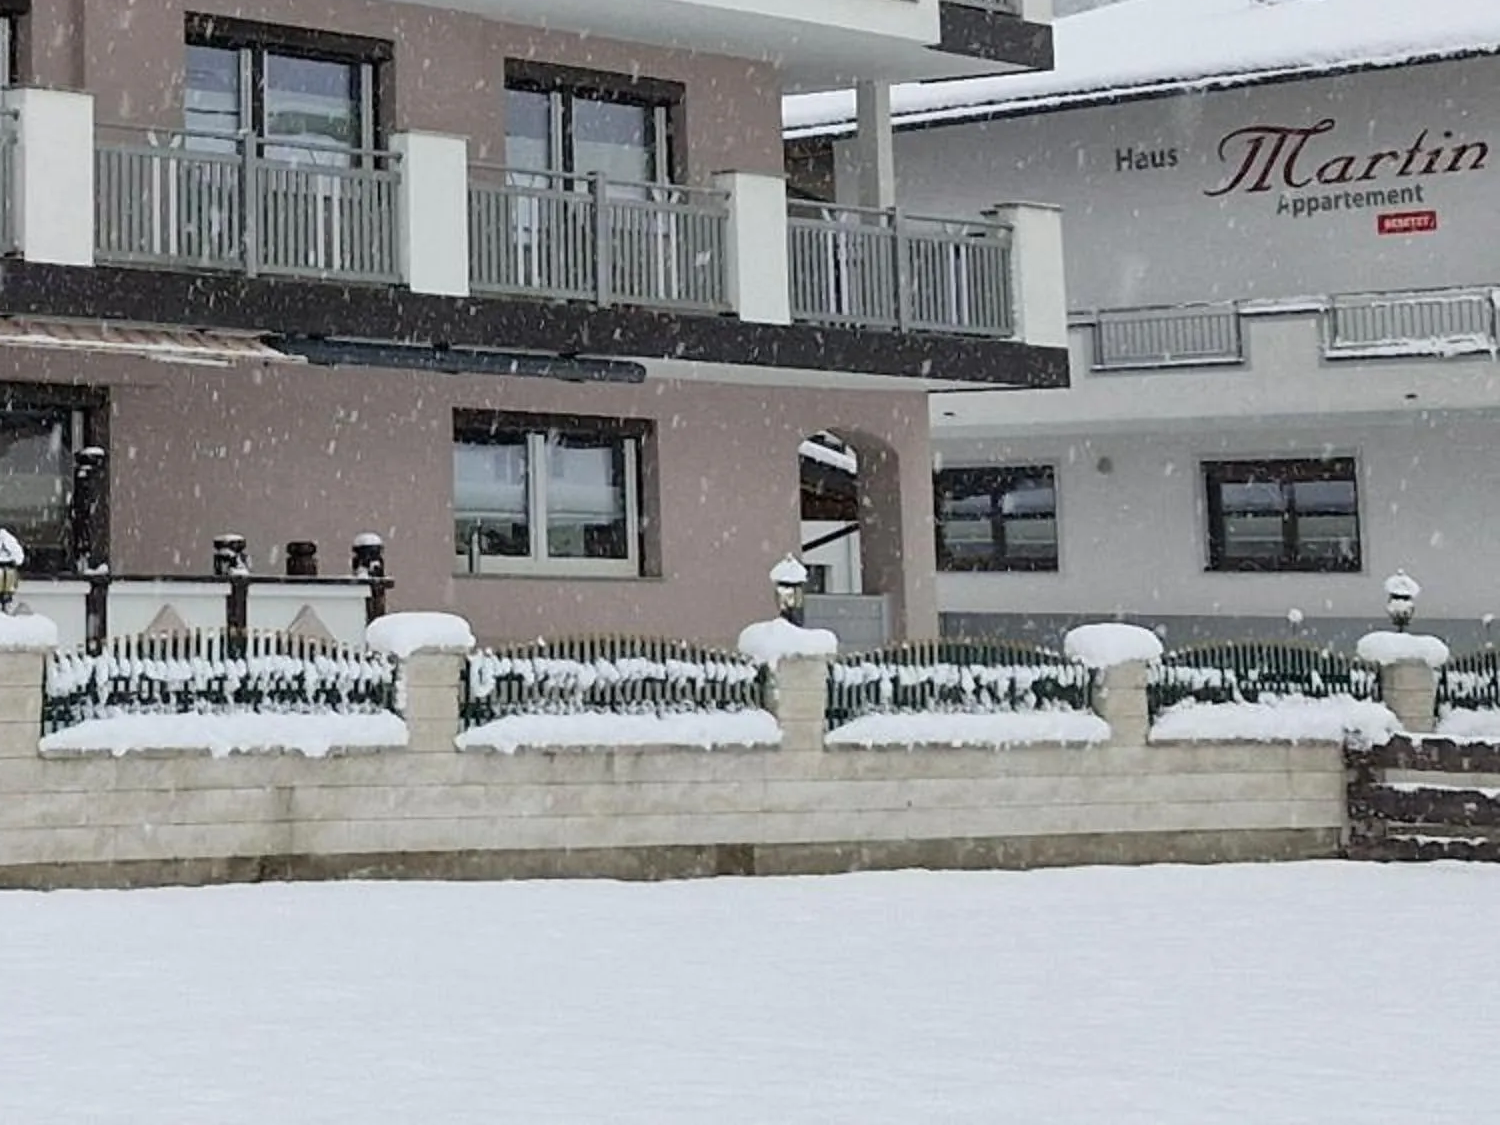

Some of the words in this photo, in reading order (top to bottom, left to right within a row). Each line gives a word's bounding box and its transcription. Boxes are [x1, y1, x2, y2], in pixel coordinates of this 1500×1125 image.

[1115, 147, 1179, 172] Haus
[1203, 118, 1489, 197] Martin
[1276, 183, 1424, 218] Appartement
